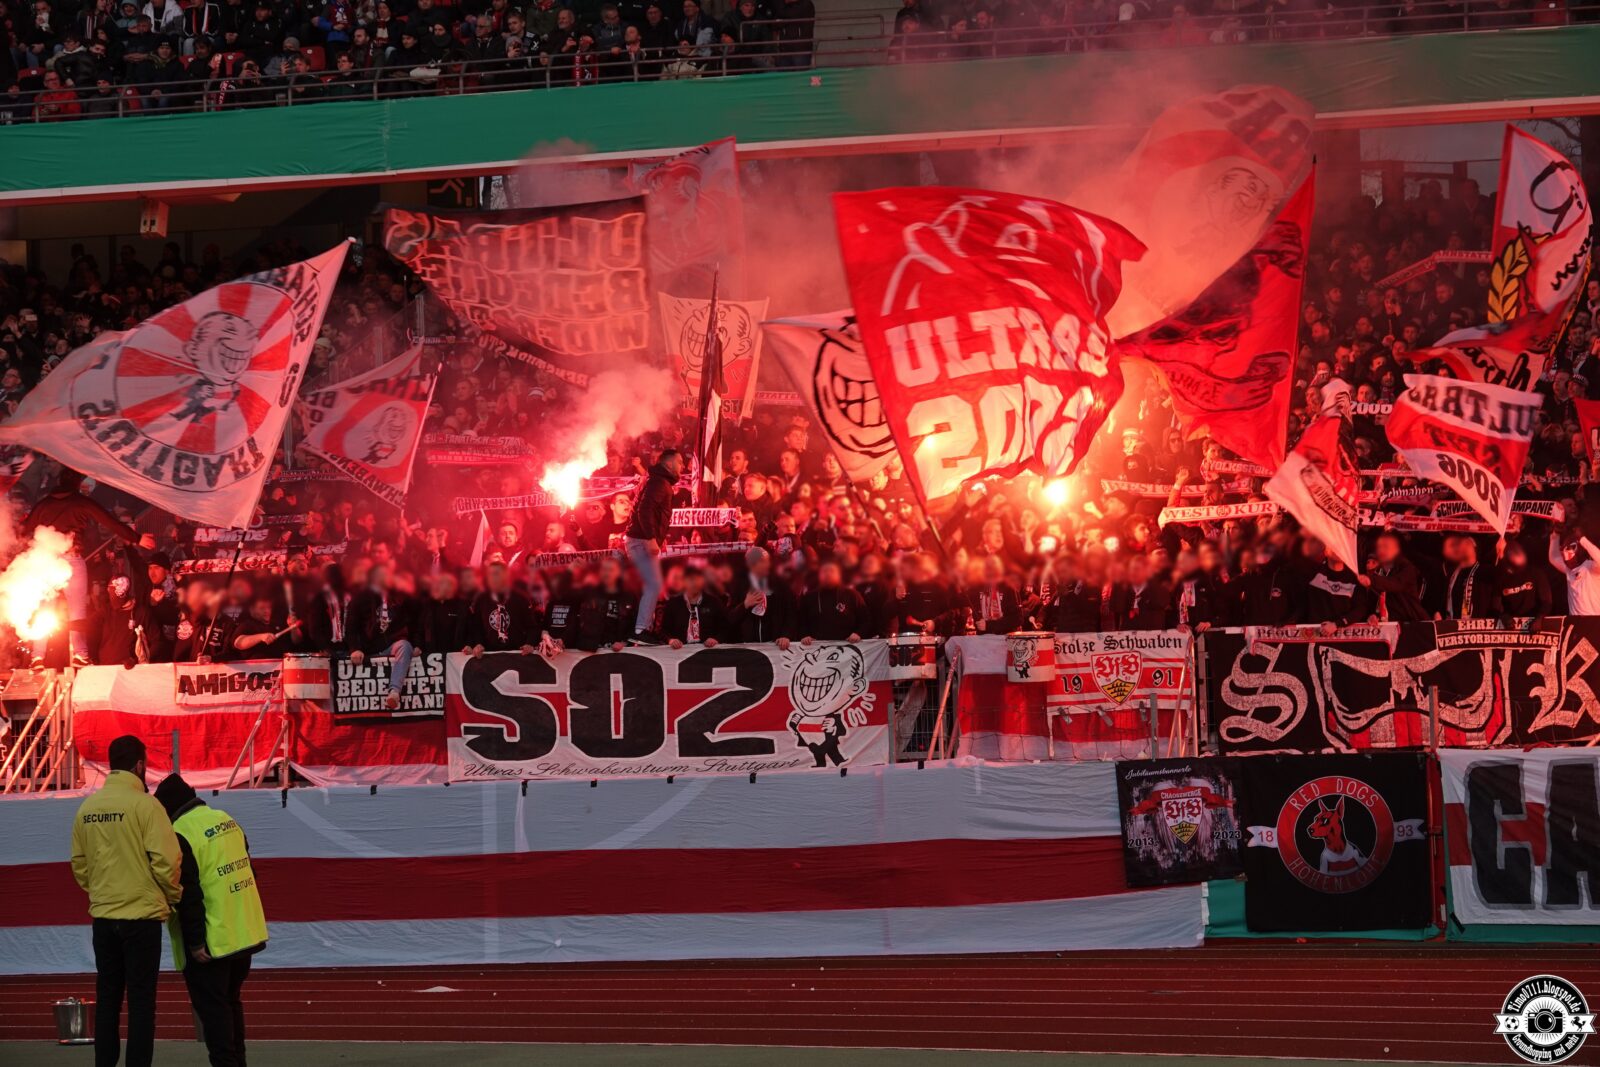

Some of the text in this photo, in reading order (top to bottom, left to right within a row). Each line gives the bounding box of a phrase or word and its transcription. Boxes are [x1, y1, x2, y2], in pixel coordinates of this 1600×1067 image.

[884, 306, 1110, 388] ULTRAS
[1511, 501, 1553, 515] OMPANIE
[1457, 619, 1495, 631] EHRE
[1104, 634, 1182, 651] Schwaben
[1437, 634, 1559, 649] VERSTORBENEN ULTRAS
[337, 652, 444, 680] ULTAS
[337, 675, 444, 697] BEDETET
[1062, 675, 1083, 693] 19
[1153, 669, 1174, 686] 91
[336, 694, 445, 712] WIDERTAND
[463, 757, 801, 777] Ultras Schwabensturm Stuttgart
[1289, 778, 1379, 811] RED DOGS
[83, 812, 125, 824] SECURITY
[1213, 830, 1241, 841] 2023
[1257, 830, 1274, 843] 18
[1397, 824, 1414, 837] 93
[217, 861, 236, 877] EVENT
